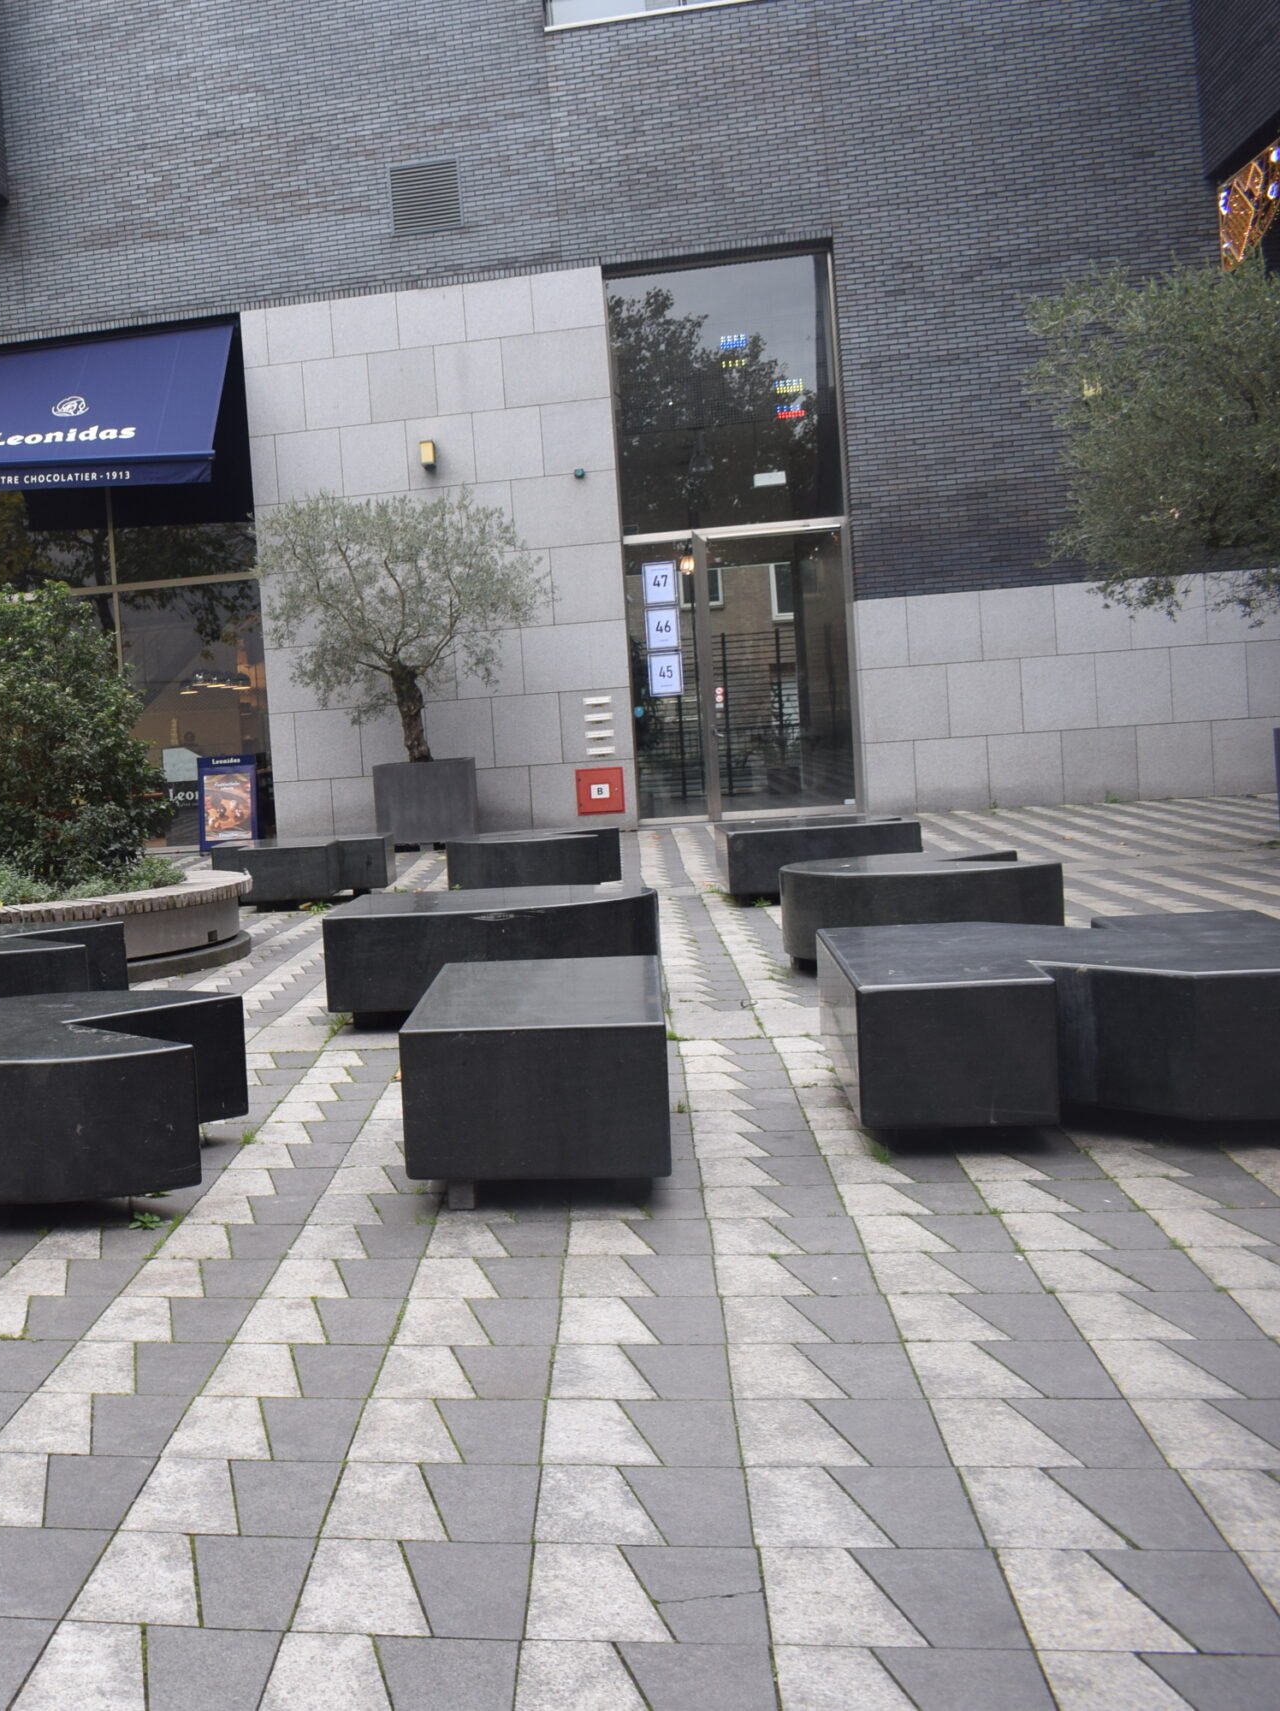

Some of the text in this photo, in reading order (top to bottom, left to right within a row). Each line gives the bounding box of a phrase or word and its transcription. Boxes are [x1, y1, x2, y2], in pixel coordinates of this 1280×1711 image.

[24, 471, 97, 484] CHOCOLATIER
[105, 470, 130, 480] 1913
[652, 574, 668, 588] 47
[655, 620, 671, 633] 46
[659, 665, 673, 679] 45
[212, 757, 241, 765] Leonidas
[597, 787, 603, 796] B
